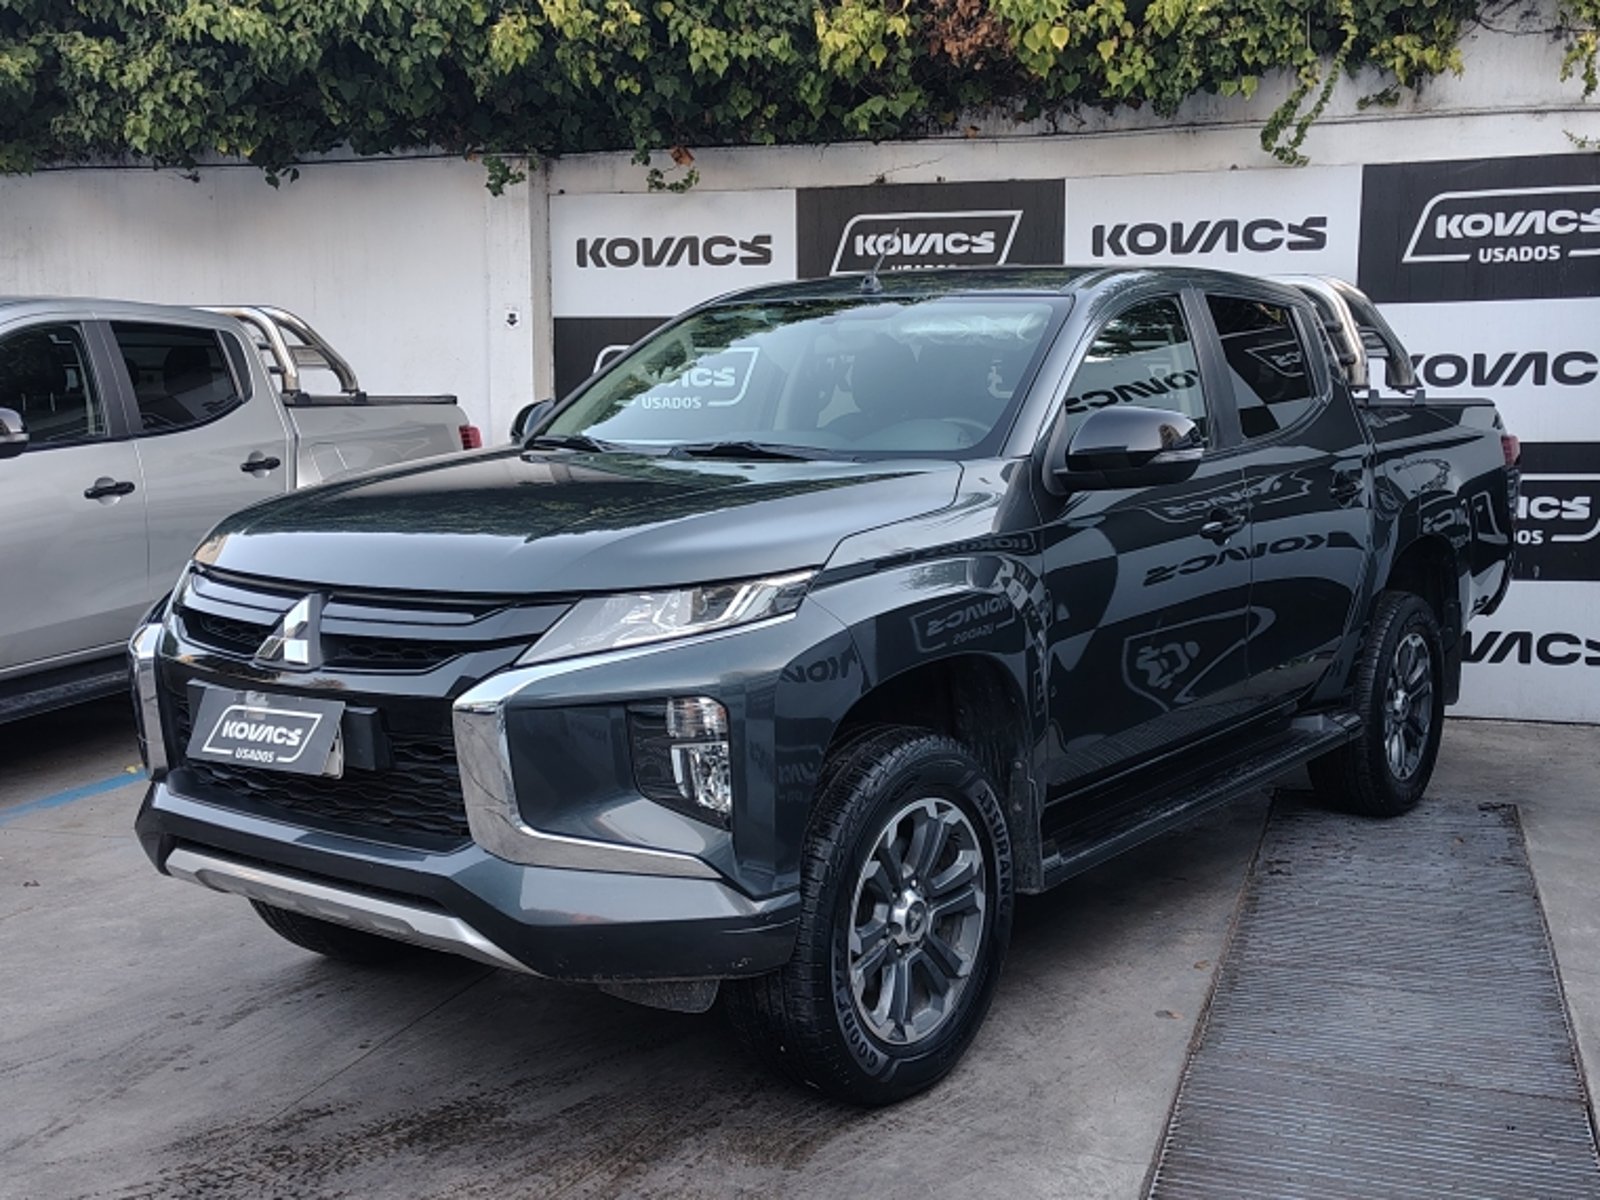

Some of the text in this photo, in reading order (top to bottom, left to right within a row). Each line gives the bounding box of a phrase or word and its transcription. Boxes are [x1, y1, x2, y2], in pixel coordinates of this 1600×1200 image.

[1092, 216, 1327, 257] KOVACS
[1435, 208, 1600, 239] KOVACS
[576, 235, 773, 268] KOVACS
[854, 231, 996, 256] KOVACS
[1478, 246, 1561, 263] USADOS
[641, 396, 702, 410] USADOS
[1461, 631, 1600, 666] VAC
[221, 719, 303, 747] KOVACS
[234, 746, 274, 763] USADOS
